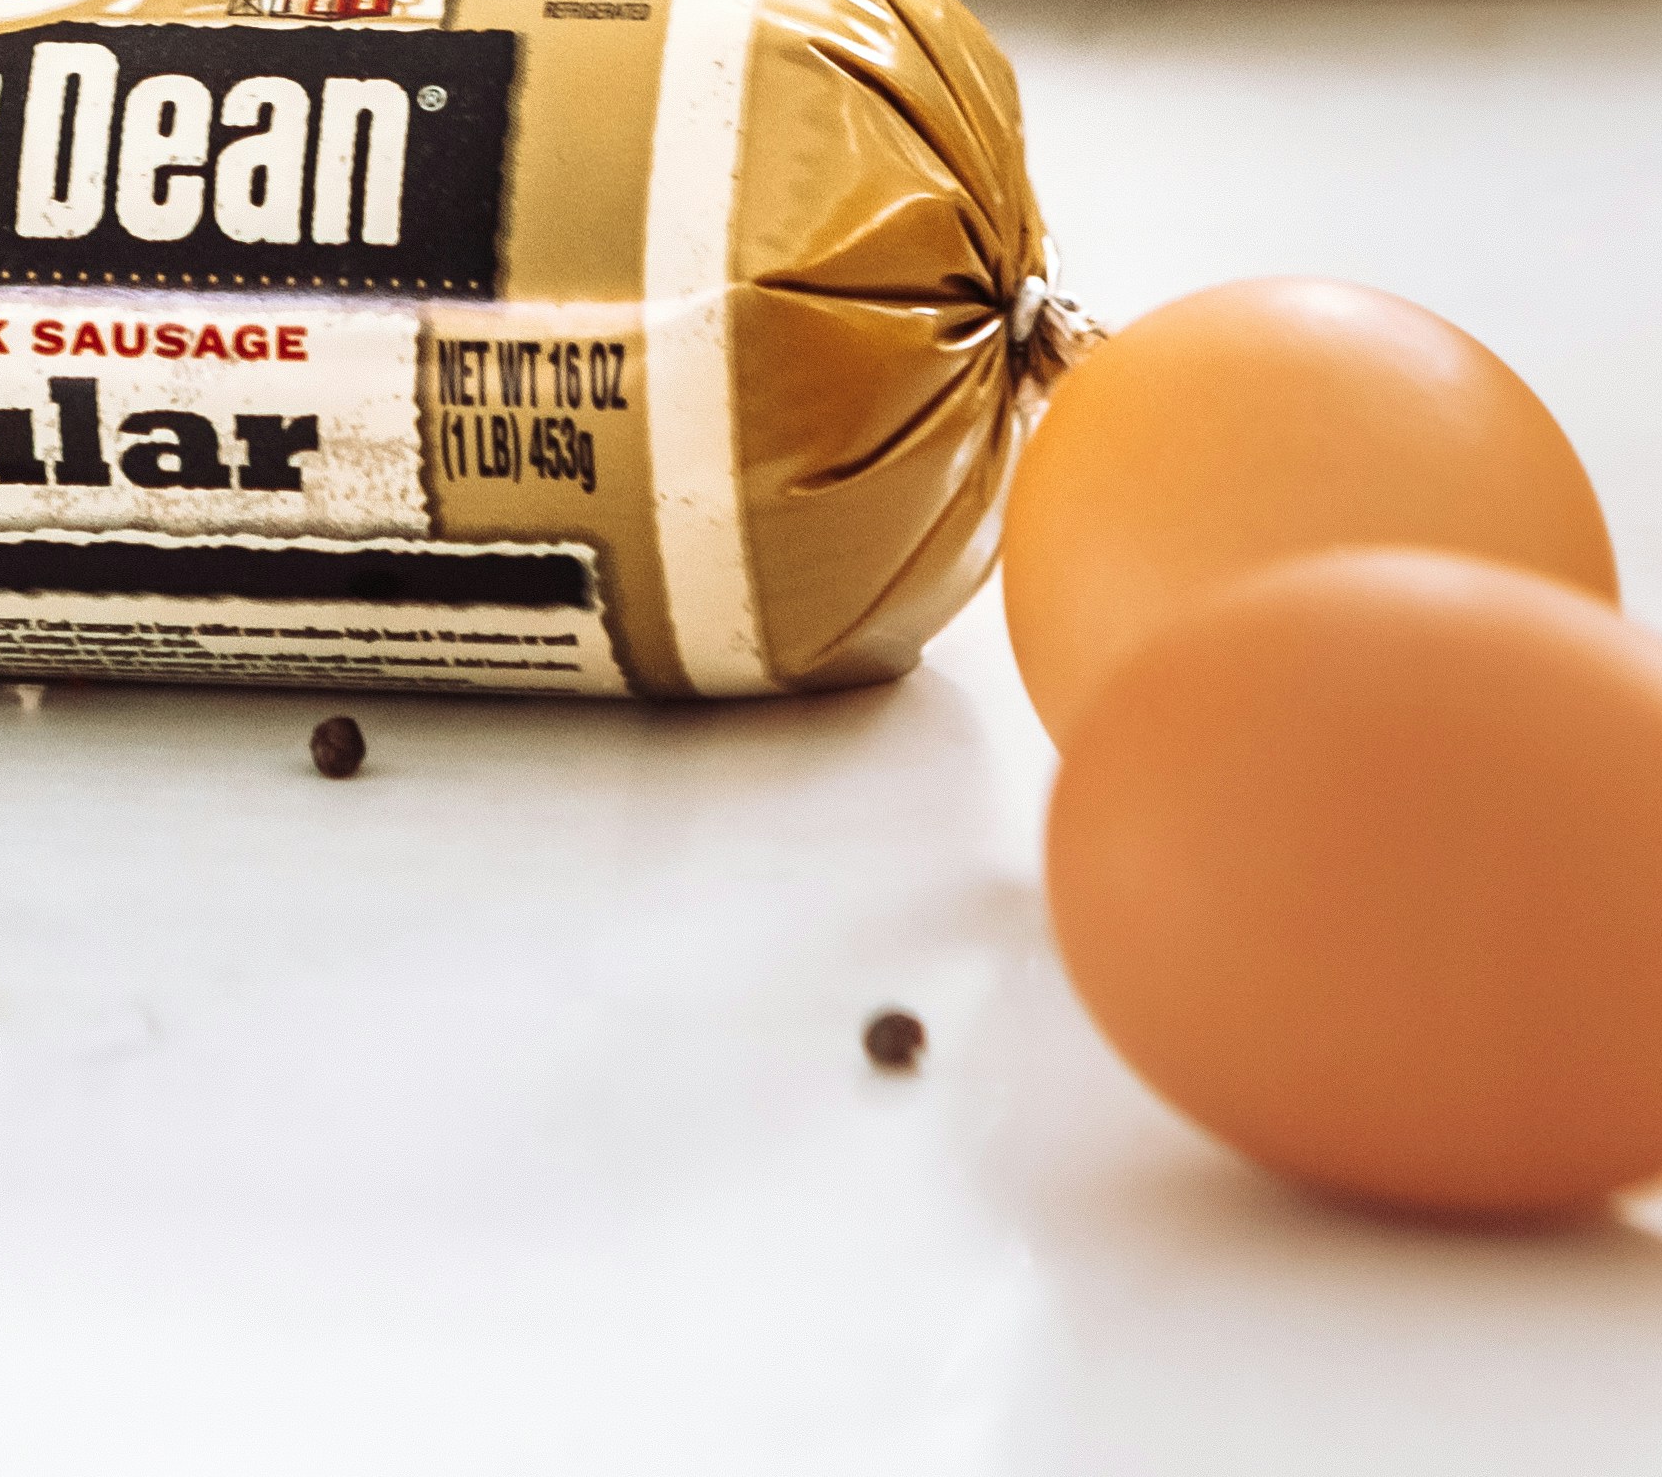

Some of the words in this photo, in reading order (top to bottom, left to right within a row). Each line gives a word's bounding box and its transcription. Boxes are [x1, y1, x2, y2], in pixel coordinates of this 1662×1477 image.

[30, 320, 311, 362] SAUSAGE
[437, 339, 490, 407] NET
[496, 339, 542, 408] WT
[548, 342, 582, 409] 16
[589, 341, 628, 411] OZ
[440, 410, 468, 483] (1
[475, 411, 523, 484] LB)
[528, 417, 597, 494] 453g
